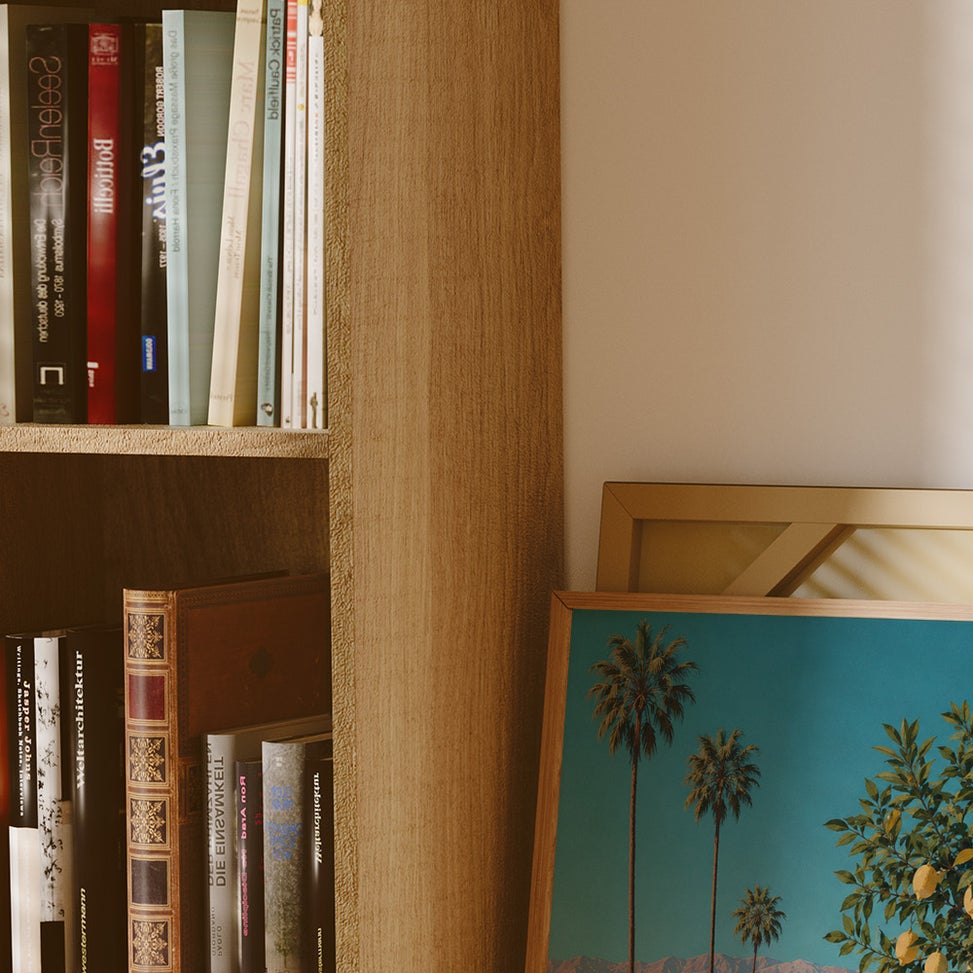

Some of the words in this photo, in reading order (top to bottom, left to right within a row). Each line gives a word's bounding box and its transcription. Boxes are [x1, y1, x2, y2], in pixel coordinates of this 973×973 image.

[22, 681, 32, 732] Jasper
[74, 650, 85, 790] Weltarchitektur
[24, 736, 33, 781] Johns
